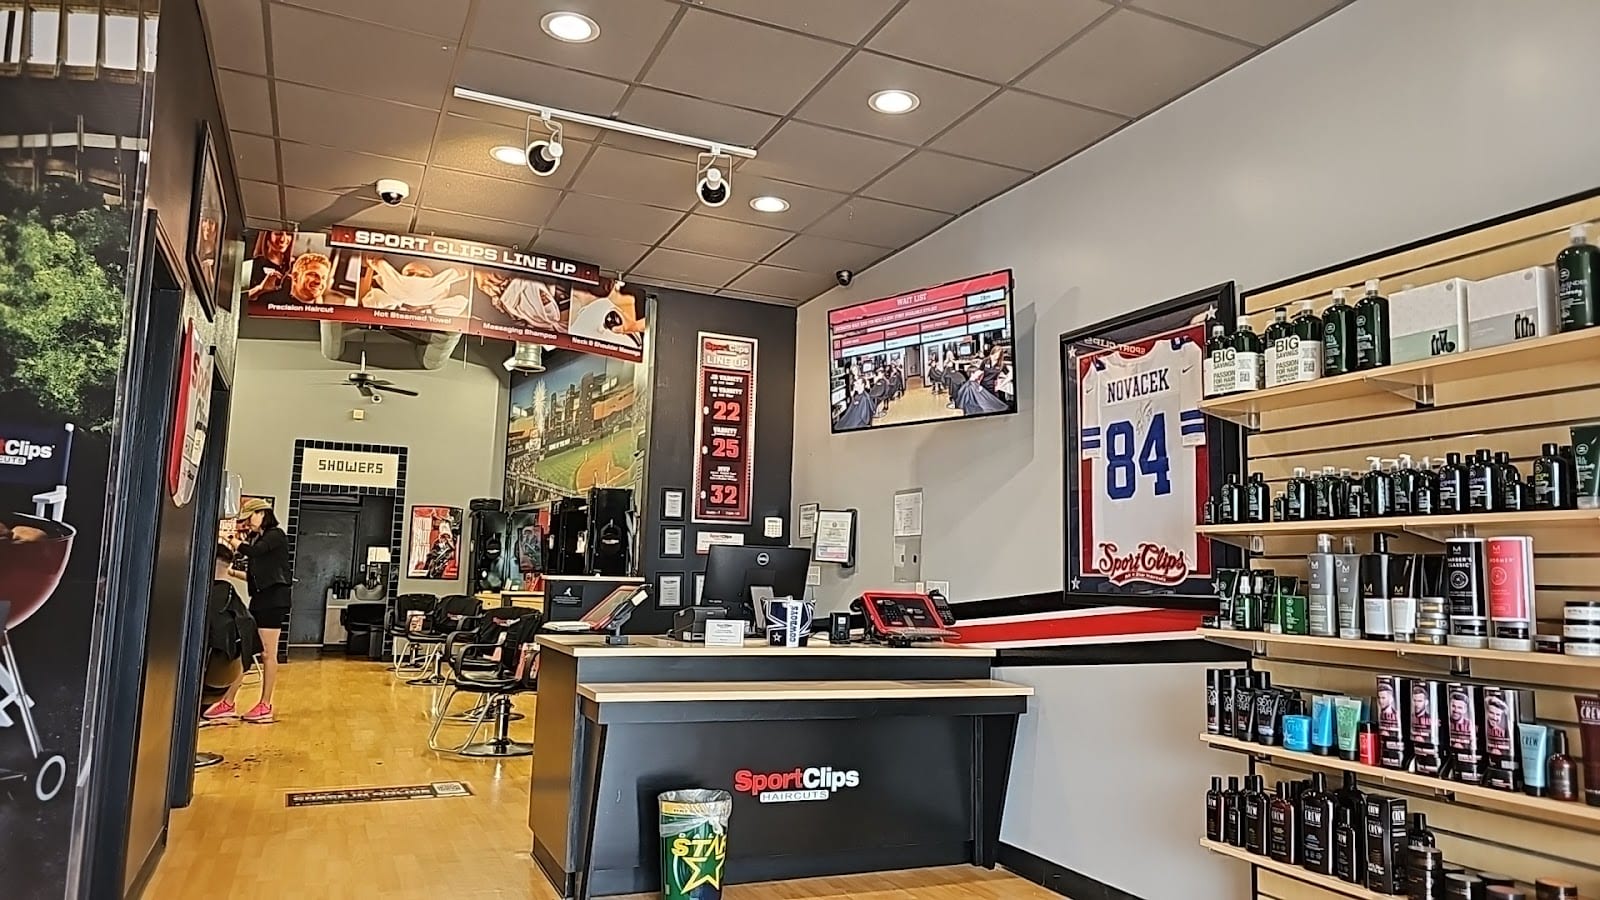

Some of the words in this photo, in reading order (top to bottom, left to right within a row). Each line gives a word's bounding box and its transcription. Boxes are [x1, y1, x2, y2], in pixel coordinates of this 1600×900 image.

[355, 231, 429, 251] SPORT
[433, 242, 498, 261] CLIPS
[502, 250, 548, 270] LINE
[551, 260, 577, 275] UP
[915, 293, 927, 302] LIST
[267, 303, 304, 312] Precision
[305, 305, 334, 313] Haircut
[373, 310, 389, 318] Hot
[390, 312, 427, 322] Steamed
[429, 315, 452, 324] Towel
[483, 322, 523, 336] Massaging
[524, 328, 558, 341] Shampoo
[1276, 337, 1299, 352] BIG
[706, 355, 732, 364] LINE
[734, 359, 749, 367] UP
[1213, 349, 1235, 363] BIG
[1107, 368, 1169, 403] NOVACEK
[713, 401, 740, 421] 22
[712, 438, 739, 458] 25
[1106, 413, 1171, 500] 84
[318, 459, 383, 474] SHOWERS
[710, 485, 737, 504] 32
[1364, 584, 1372, 592] M
[1257, 697, 1274, 706] SEXY
[1522, 735, 1538, 747] CREW
[735, 767, 859, 795] SportClips
[763, 791, 827, 801] HAIRCUTS
[1304, 809, 1321, 822] CREW
[1368, 823, 1383, 835] CREW
